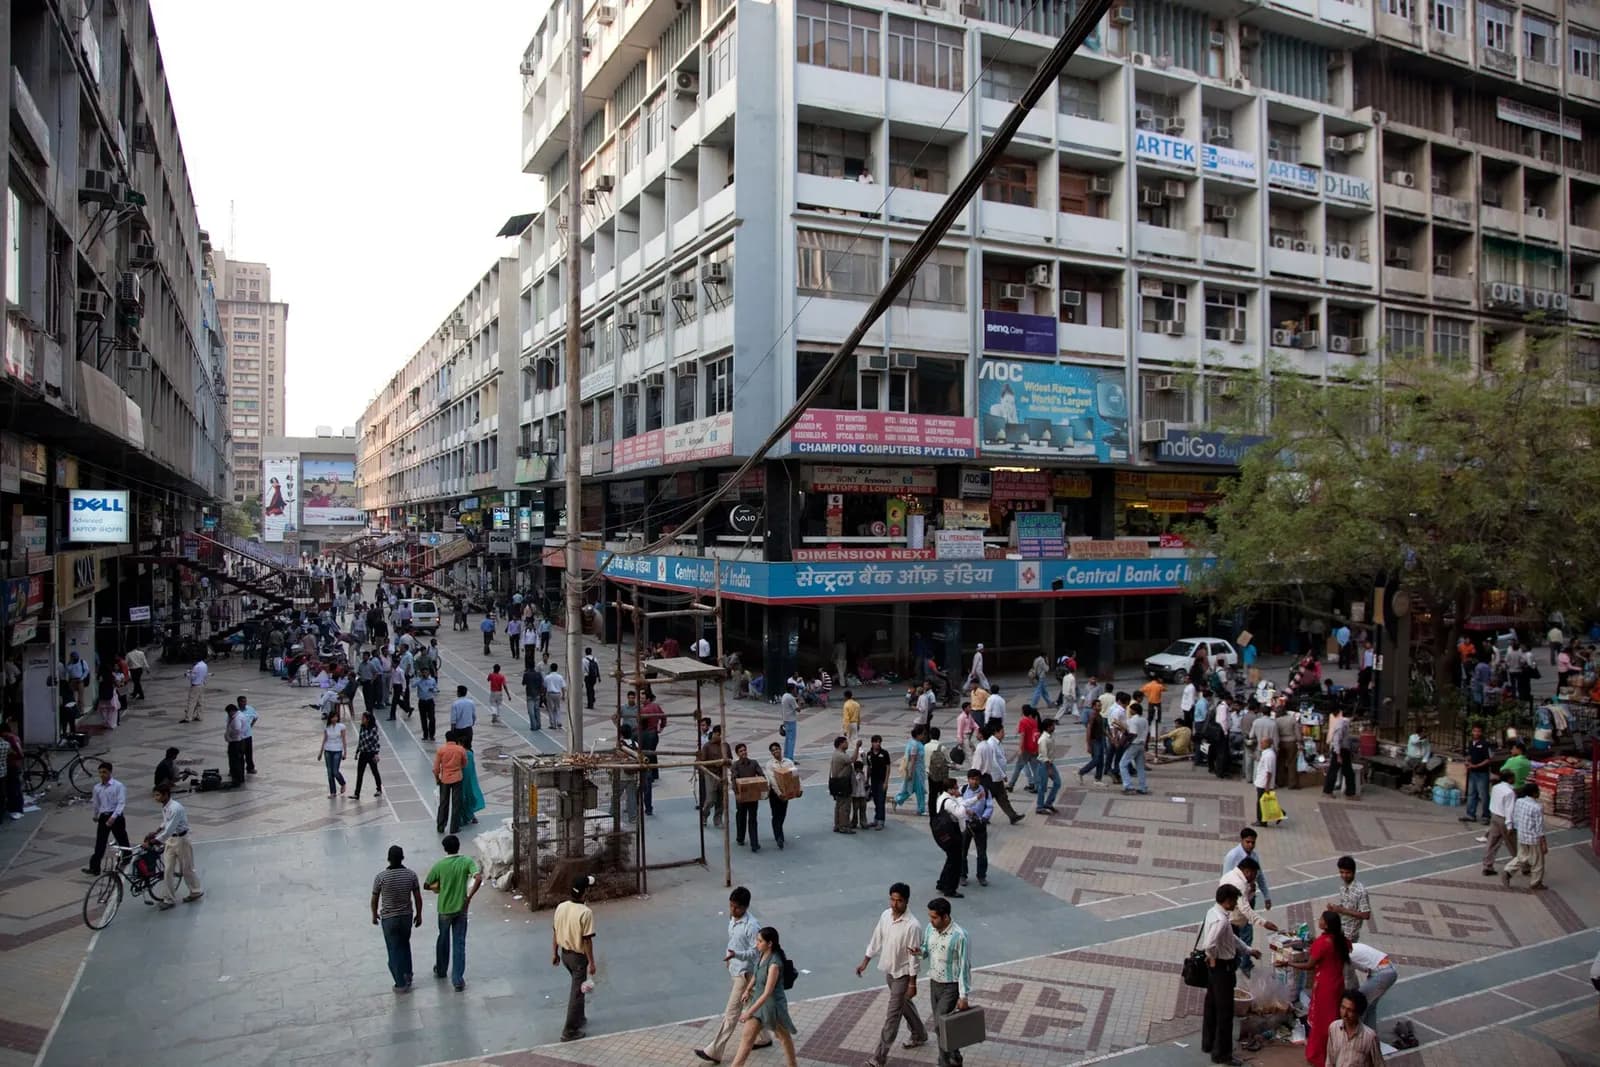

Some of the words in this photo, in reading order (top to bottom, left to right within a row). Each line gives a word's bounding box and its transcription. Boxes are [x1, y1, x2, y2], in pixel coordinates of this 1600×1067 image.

[1136, 134, 1194, 162] ARTEK
[1269, 162, 1317, 185] ARTEK
[1325, 175, 1370, 201] D-Link
[978, 361, 1024, 382] AOC
[1052, 384, 1077, 396] Range
[799, 443, 856, 453] CHAMPION
[859, 444, 922, 455] COMPUTERS
[924, 447, 945, 456] PVT.
[947, 447, 969, 457] LTD.
[964, 473, 980, 484] AOC
[73, 498, 123, 511] DELL
[797, 550, 887, 560] DIMENSION
[891, 549, 931, 559] NEXT
[675, 563, 699, 581] Central
[730, 567, 751, 588] India
[859, 565, 894, 585] बैंक
[943, 563, 993, 586] इंडिया
[1066, 564, 1122, 584] Central
[1125, 564, 1162, 583] Bank
[1165, 564, 1182, 581] of
